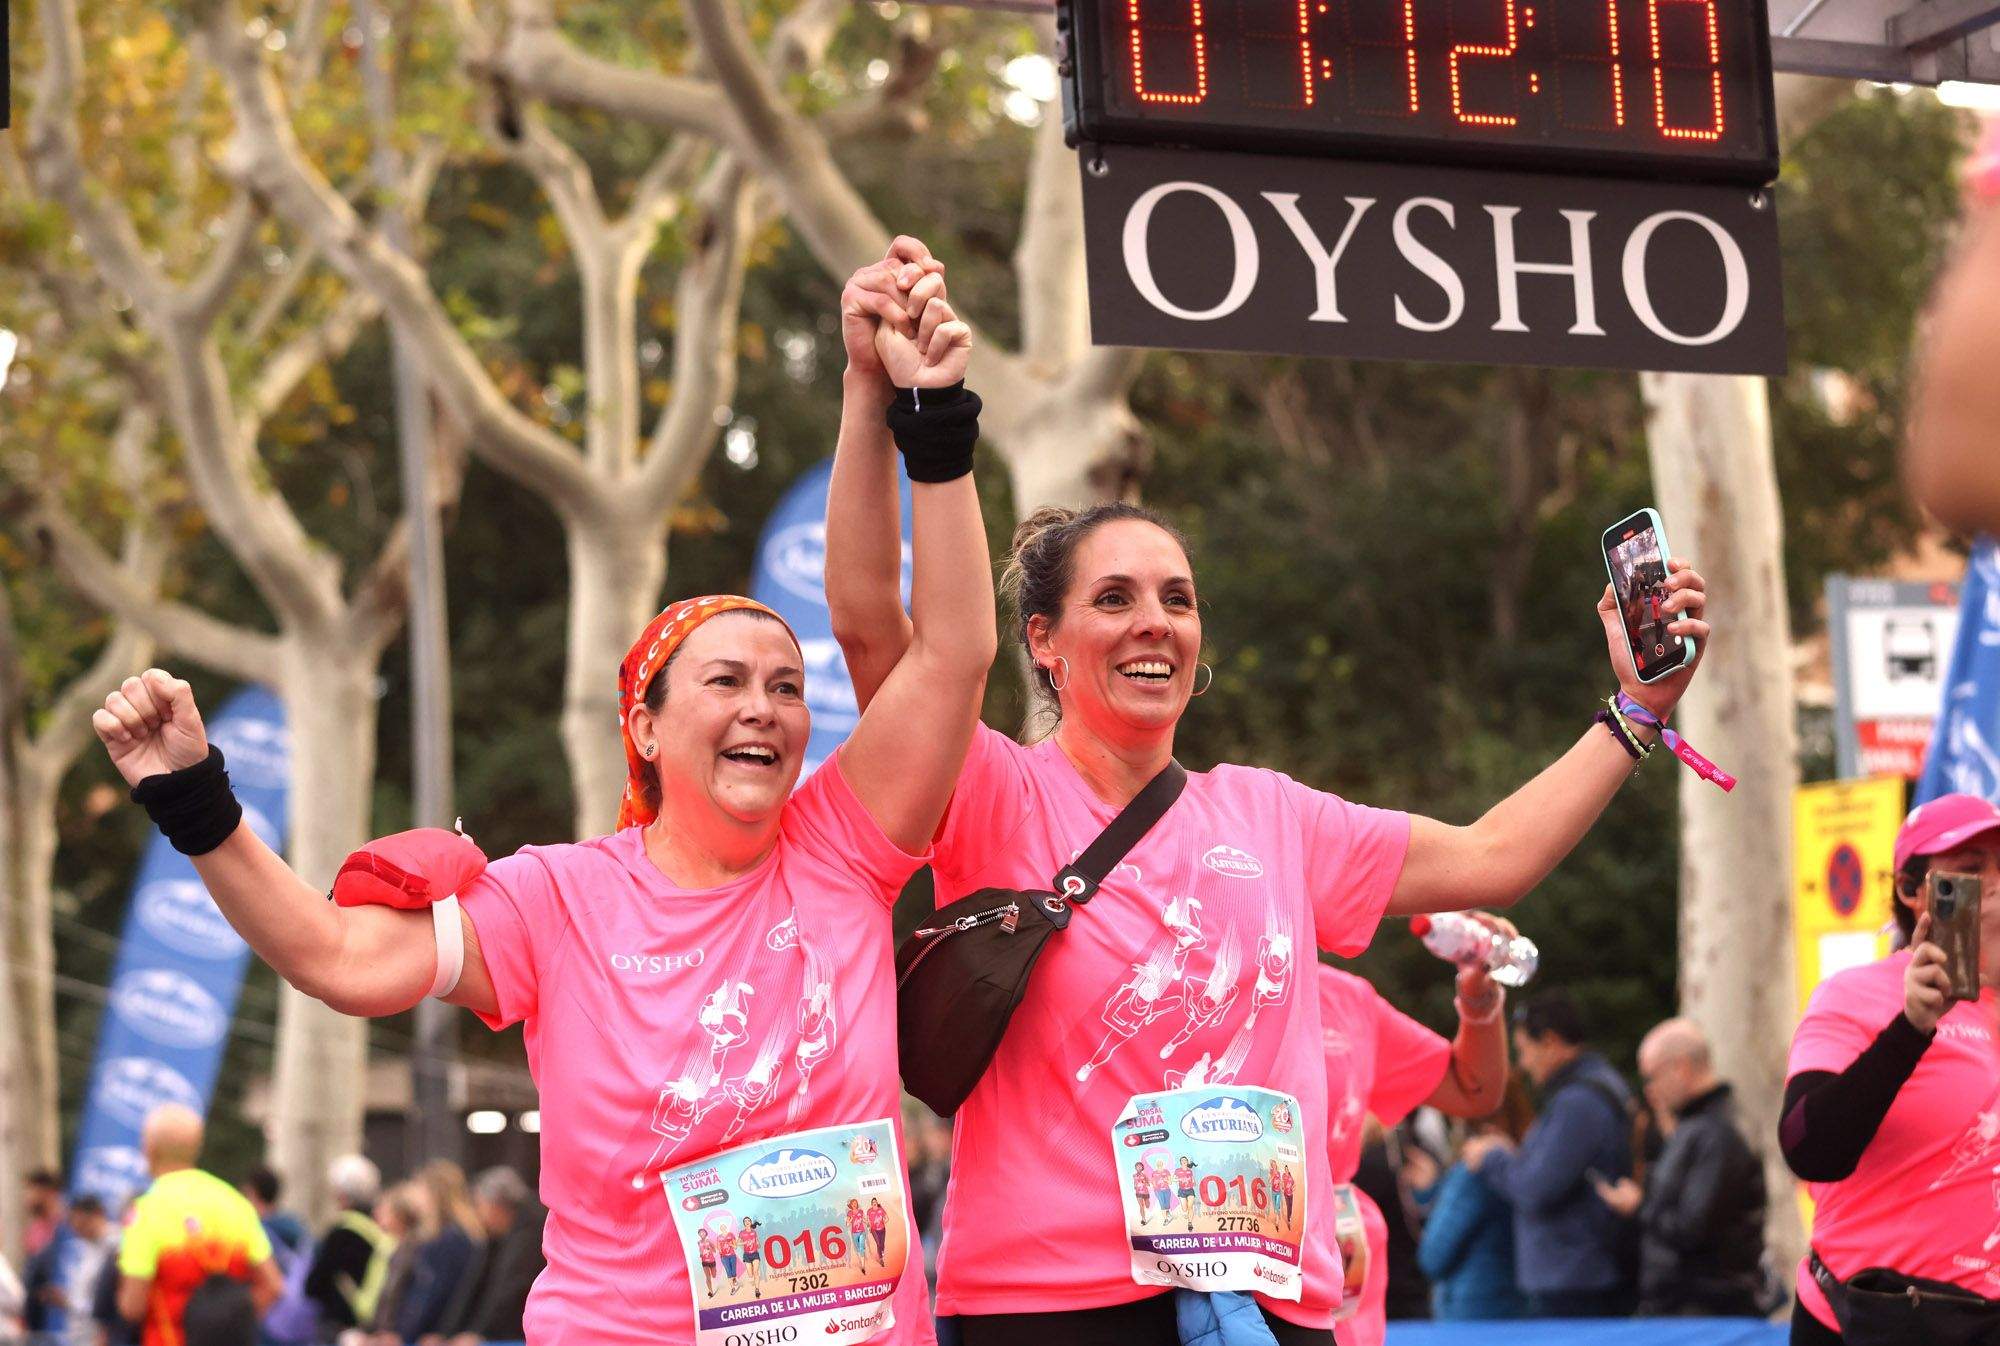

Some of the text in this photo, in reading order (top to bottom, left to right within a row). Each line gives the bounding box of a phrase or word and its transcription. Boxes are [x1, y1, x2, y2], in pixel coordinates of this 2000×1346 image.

[1121, 180, 1750, 346] OYSHO
[611, 948, 705, 974] OYSHO
[1126, 1115, 1165, 1129] SUMA
[682, 1175, 721, 1193] SUMA
[1199, 1174, 1268, 1210] 016
[1217, 1217, 1260, 1233] 27736
[763, 1225, 847, 1269] 016
[1152, 1237, 1199, 1250] CARRERA
[1202, 1237, 1216, 1248] DE
[1218, 1236, 1232, 1247] LA
[1234, 1236, 1262, 1249] MUJER
[1157, 1260, 1228, 1278] OYSHO
[788, 1273, 830, 1293] 7302
[720, 1283, 892, 1322] CARRERA DE LA MUJER BARCELONA
[724, 1325, 798, 1346] OYSHO
